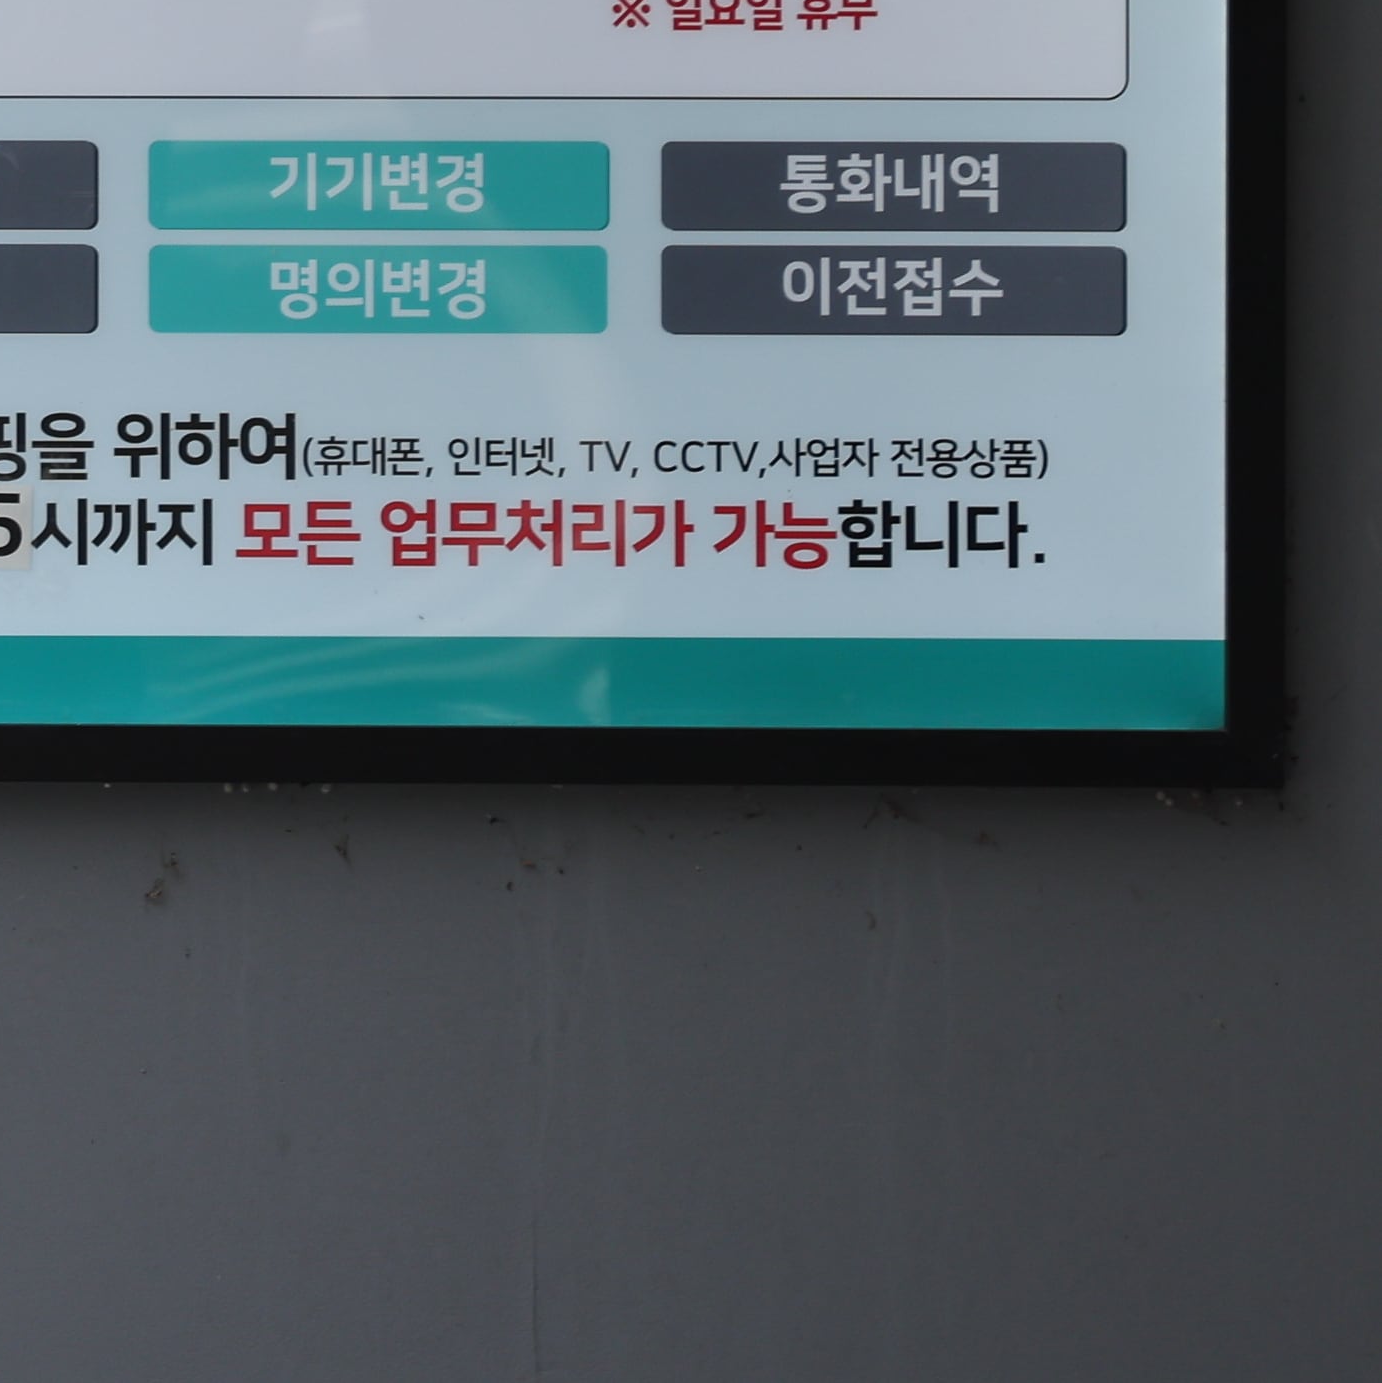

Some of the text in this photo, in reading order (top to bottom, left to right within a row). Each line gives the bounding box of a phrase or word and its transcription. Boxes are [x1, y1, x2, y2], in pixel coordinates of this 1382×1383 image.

[269, 152, 487, 214] 기기변경
[780, 153, 1002, 215] 통화내역
[269, 257, 488, 321] 명의변경
[781, 258, 1004, 318] 이전접수
[447, 436, 567, 480] 인터넷,
[579, 441, 640, 480] TV,
[889, 436, 1049, 481] 전용상품)
[236, 500, 361, 567] 모든
[380, 499, 694, 568] 업무처리가
[712, 499, 1046, 569] 가능합니다.
